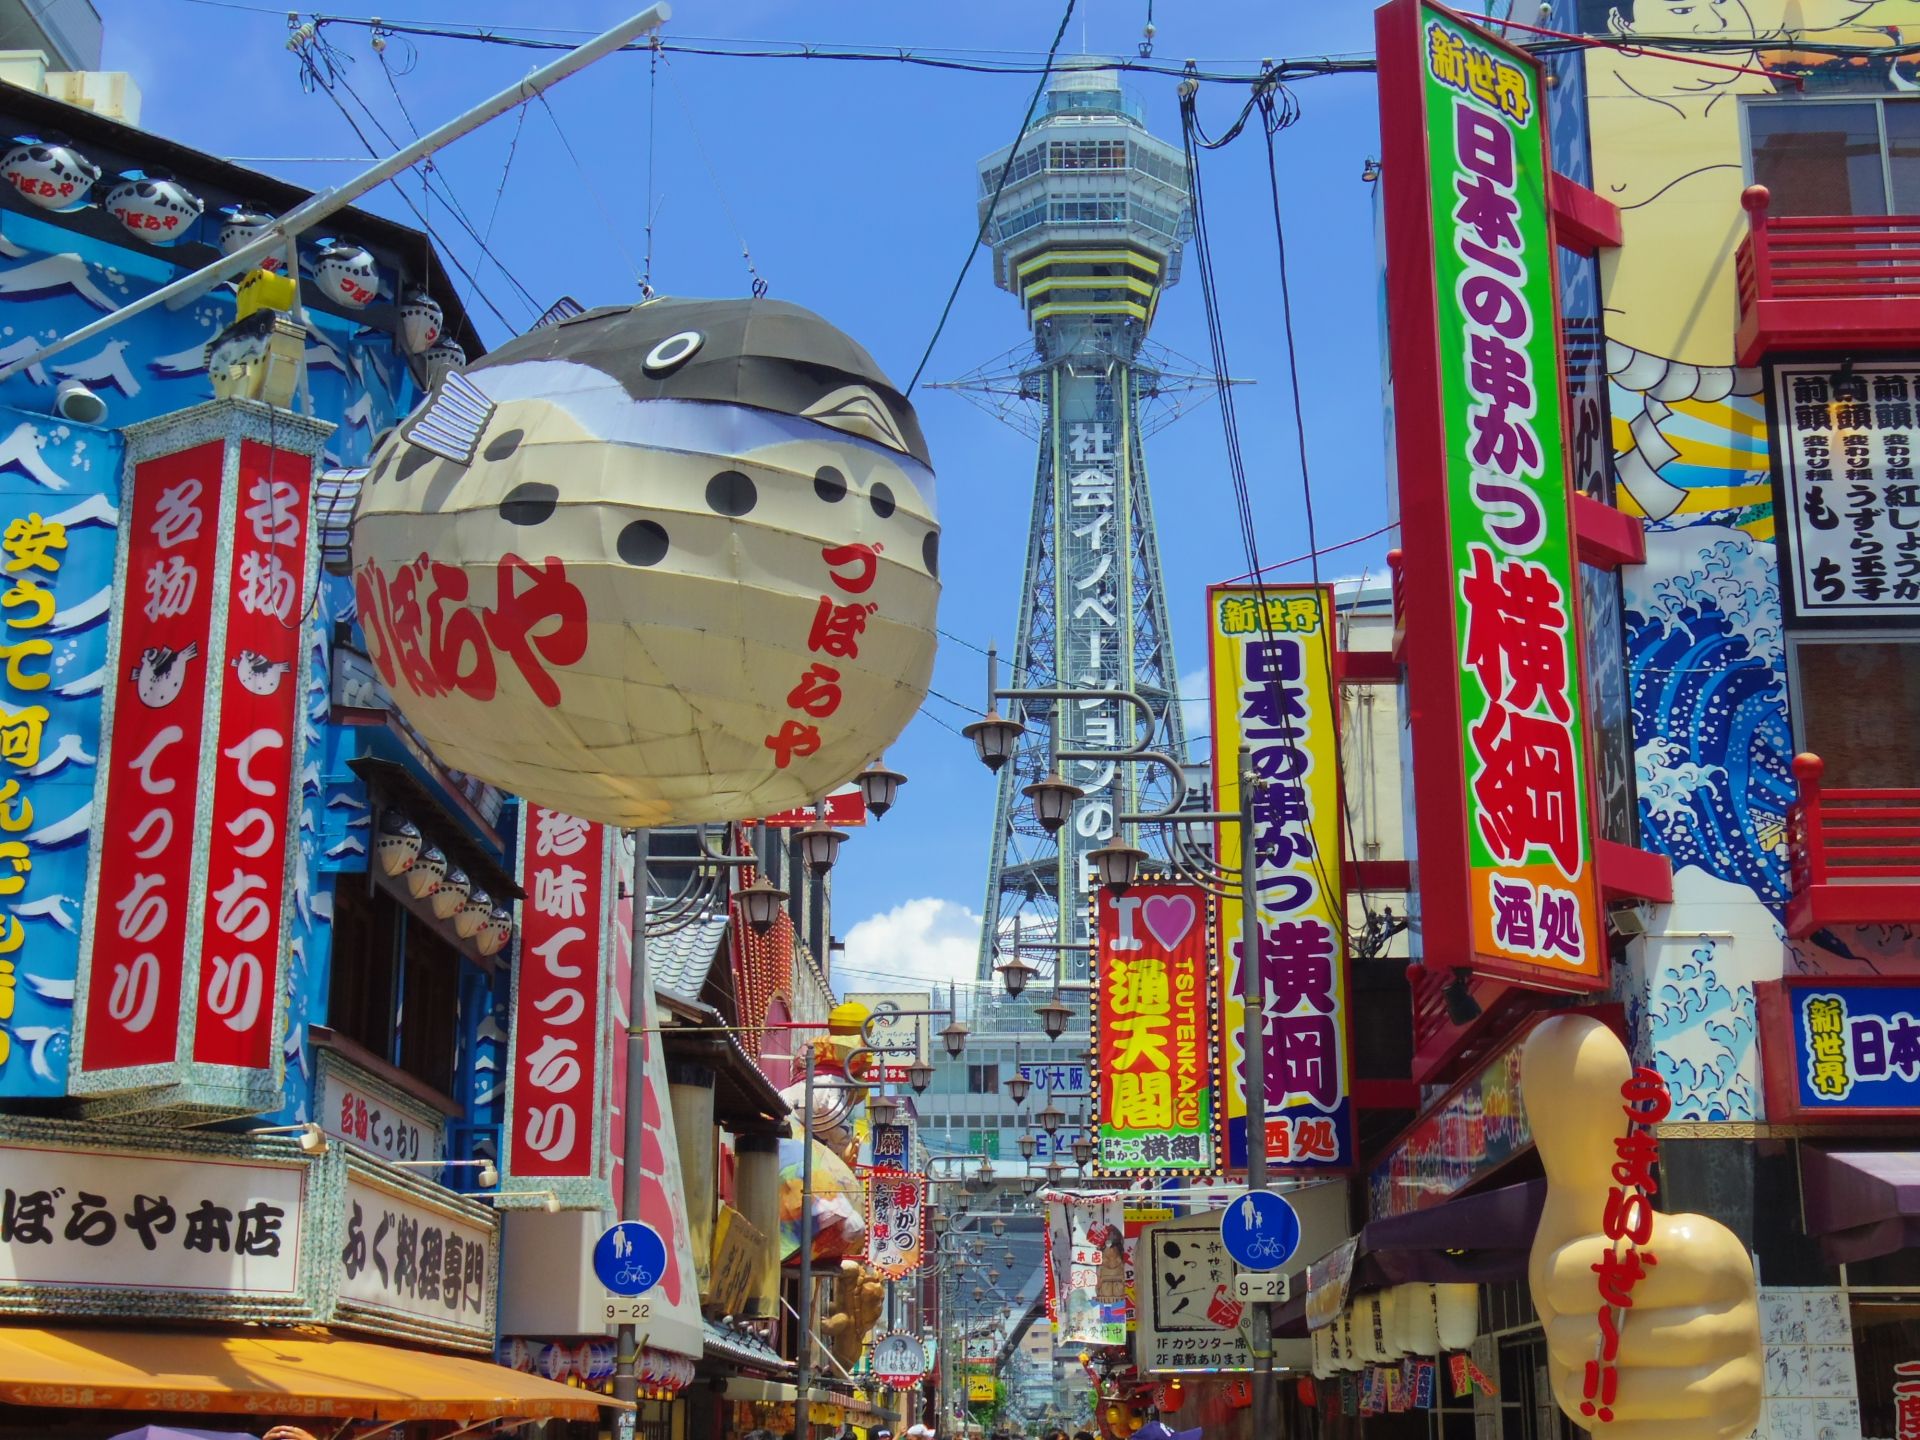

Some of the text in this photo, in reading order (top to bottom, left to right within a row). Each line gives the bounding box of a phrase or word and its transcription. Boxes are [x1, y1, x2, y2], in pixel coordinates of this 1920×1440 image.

[1430, 24, 1530, 123] 新世界
[1455, 103, 1541, 545] 日本一の串かつ
[1804, 485, 1846, 602] もち
[764, 542, 885, 769] づぼらや
[1069, 423, 1117, 892] 社会イノベーションの
[1221, 598, 1320, 634] 新世界
[1463, 548, 1580, 877] 横綱
[1242, 639, 1314, 912] 日本一の串かつ
[1494, 879, 1581, 957] 酒処
[1110, 958, 1173, 1129] 通天閣
[1175, 956, 1199, 1127] TSUTENKAKU
[1232, 920, 1338, 1108] 横綱
[1807, 998, 1850, 1096] 新世界
[1141, 1134, 1201, 1162] 横綱
[341, 1200, 485, 1314] ふぐ料理専門
[892, 1183, 918, 1250] 串かつ
[1172, 1338, 1247, 1350] カウンター席
[1172, 1354, 1247, 1365] 座敷あります
